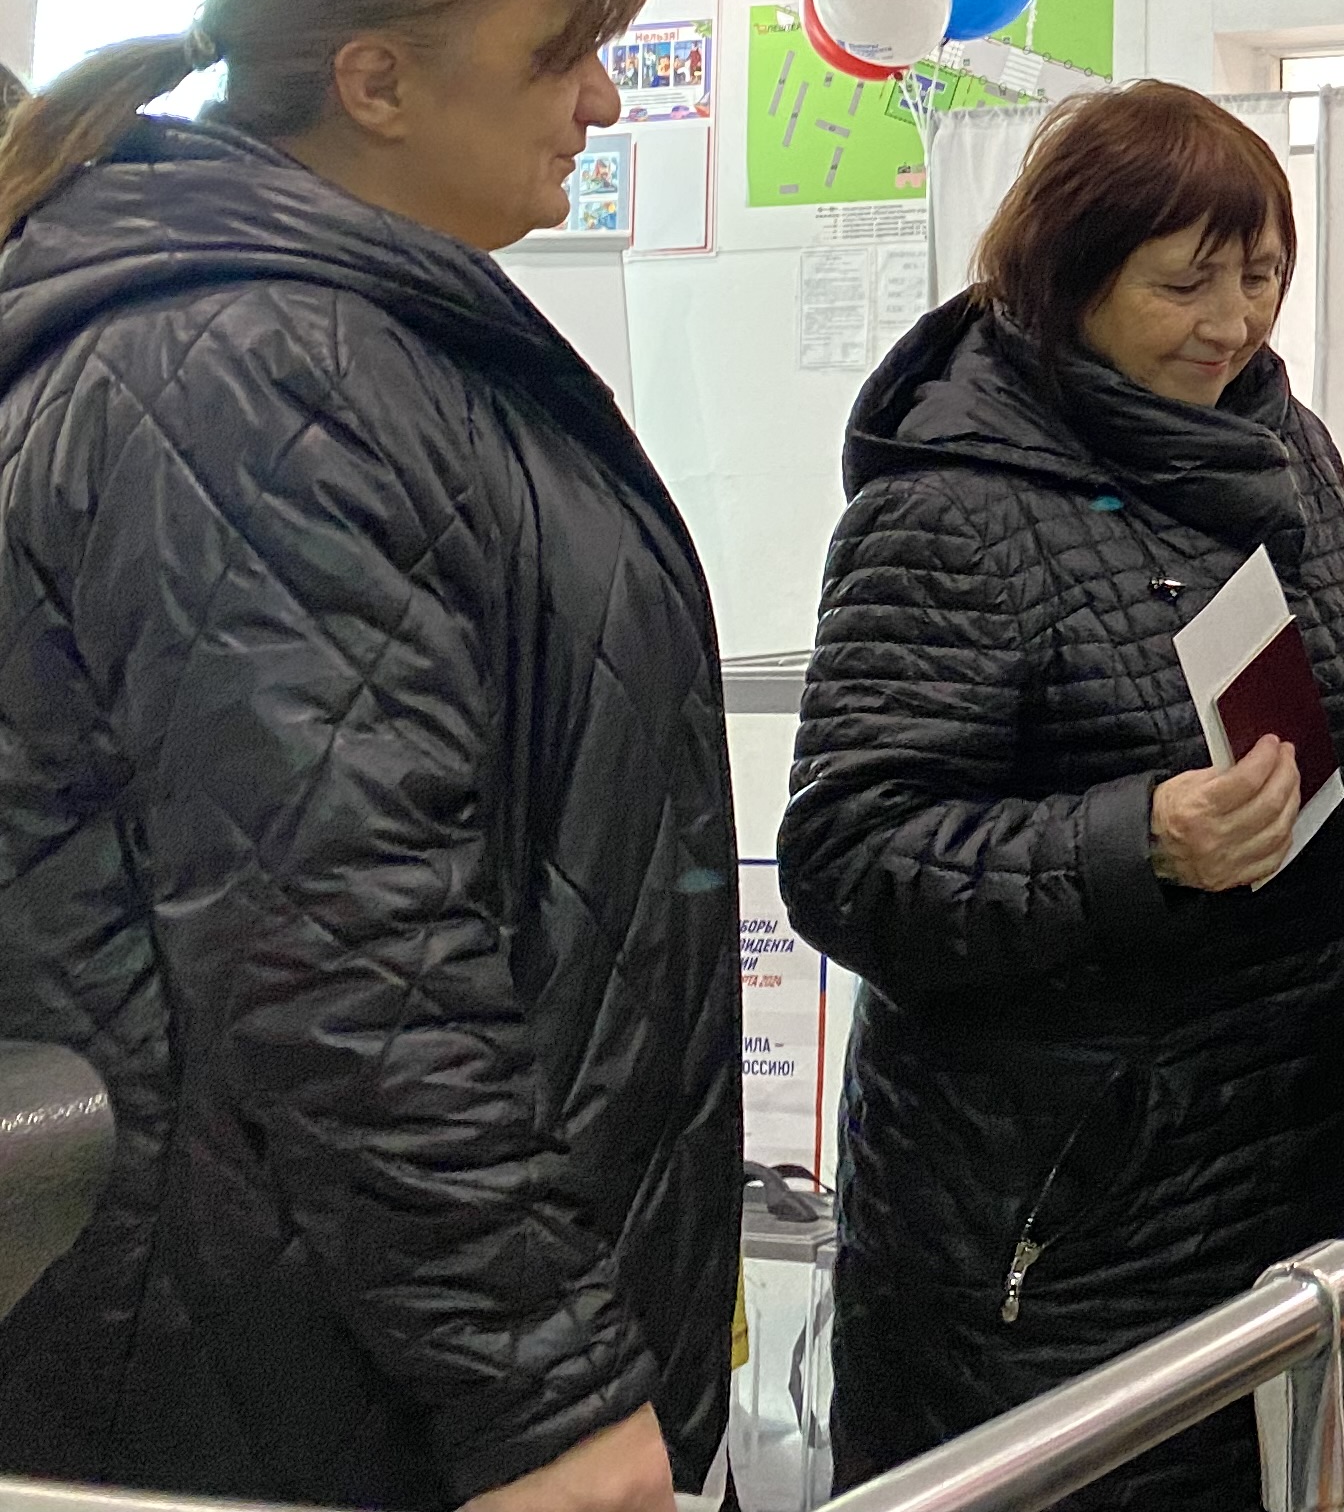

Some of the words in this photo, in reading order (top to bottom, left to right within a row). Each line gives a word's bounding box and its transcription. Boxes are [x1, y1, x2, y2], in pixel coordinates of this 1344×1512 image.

[635, 29, 680, 43] Нельзя!
[740, 920, 778, 934] БОРЫ
[741, 938, 795, 954] ИДЕНТА
[741, 957, 759, 971] ИИ
[759, 974, 782, 988] 2024
[744, 1037, 771, 1053] ИЛА
[742, 1060, 794, 1077] ОССИЮ!
